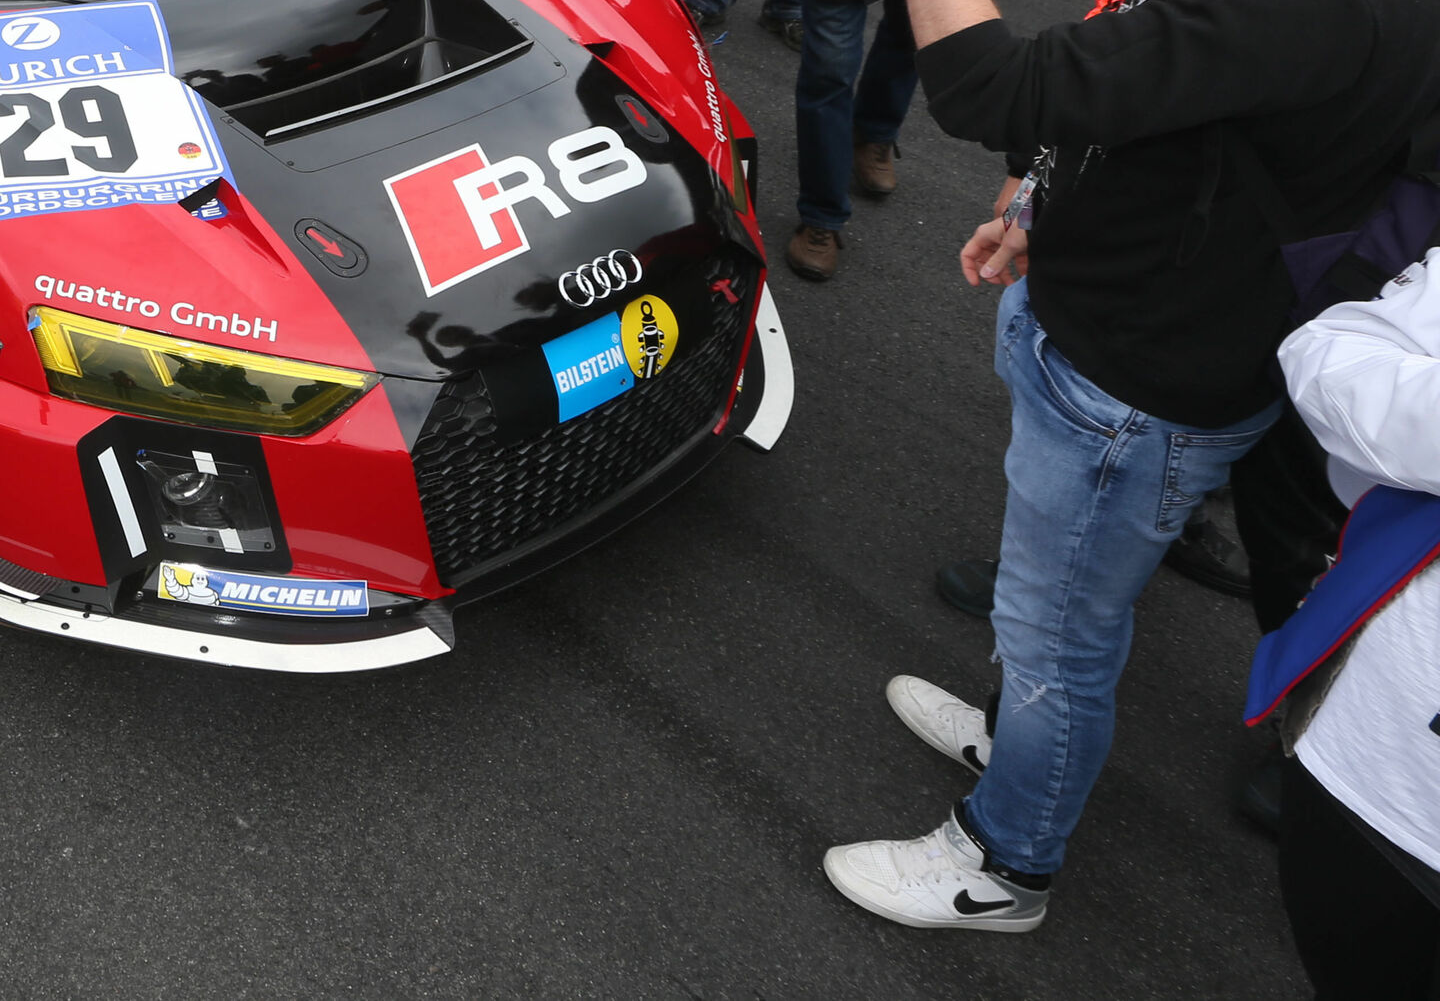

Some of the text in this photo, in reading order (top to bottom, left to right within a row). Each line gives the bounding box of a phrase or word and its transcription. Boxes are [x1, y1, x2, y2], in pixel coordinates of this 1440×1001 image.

[704, 80, 727, 143] quattro
[452, 125, 648, 251] R8
[34, 274, 278, 342] quattro GmbH
[556, 345, 625, 394] BILSTEIN
[220, 581, 363, 607] MICHELIN
